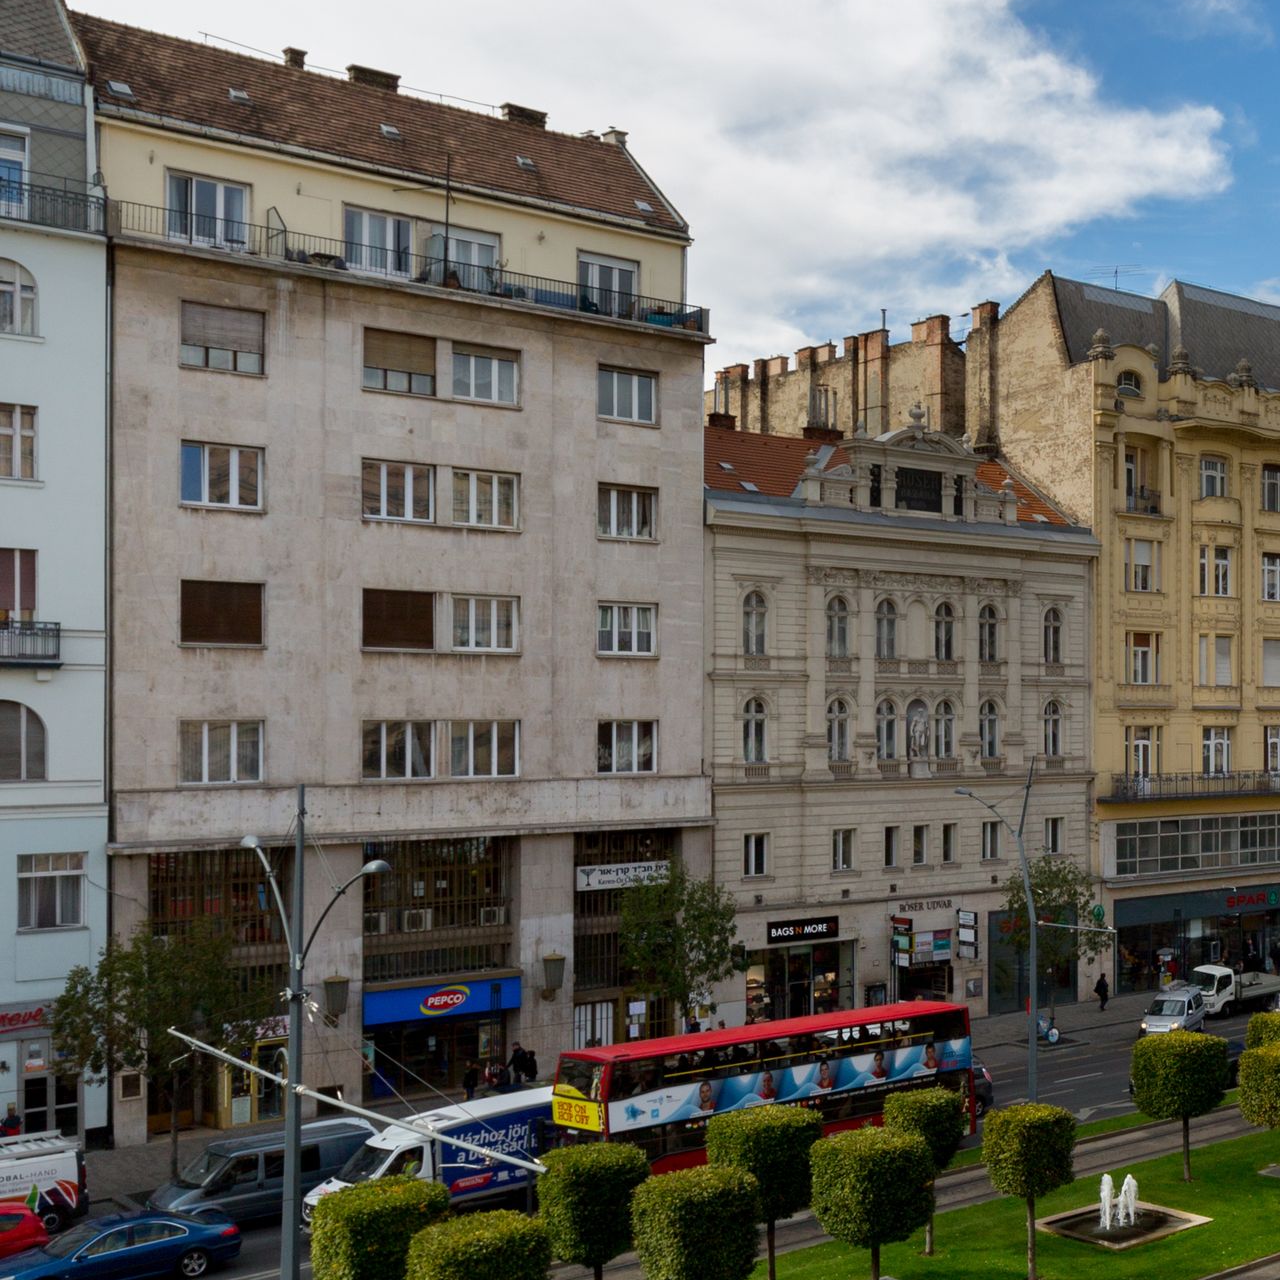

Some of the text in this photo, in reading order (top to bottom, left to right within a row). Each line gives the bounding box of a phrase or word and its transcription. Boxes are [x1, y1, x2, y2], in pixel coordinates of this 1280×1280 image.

[898, 899, 953, 913] RÖSER UDVAR
[1226, 892, 1266, 908] SPAR
[771, 926, 794, 937] BAGS
[803, 923, 828, 934] MORE
[427, 993, 462, 1007] PEPCO
[557, 1101, 587, 1114] HOP ON
[558, 1111, 590, 1125] HOP OFF
[451, 1123, 529, 1150] Házhoz jön
[456, 1151, 466, 1163] a
